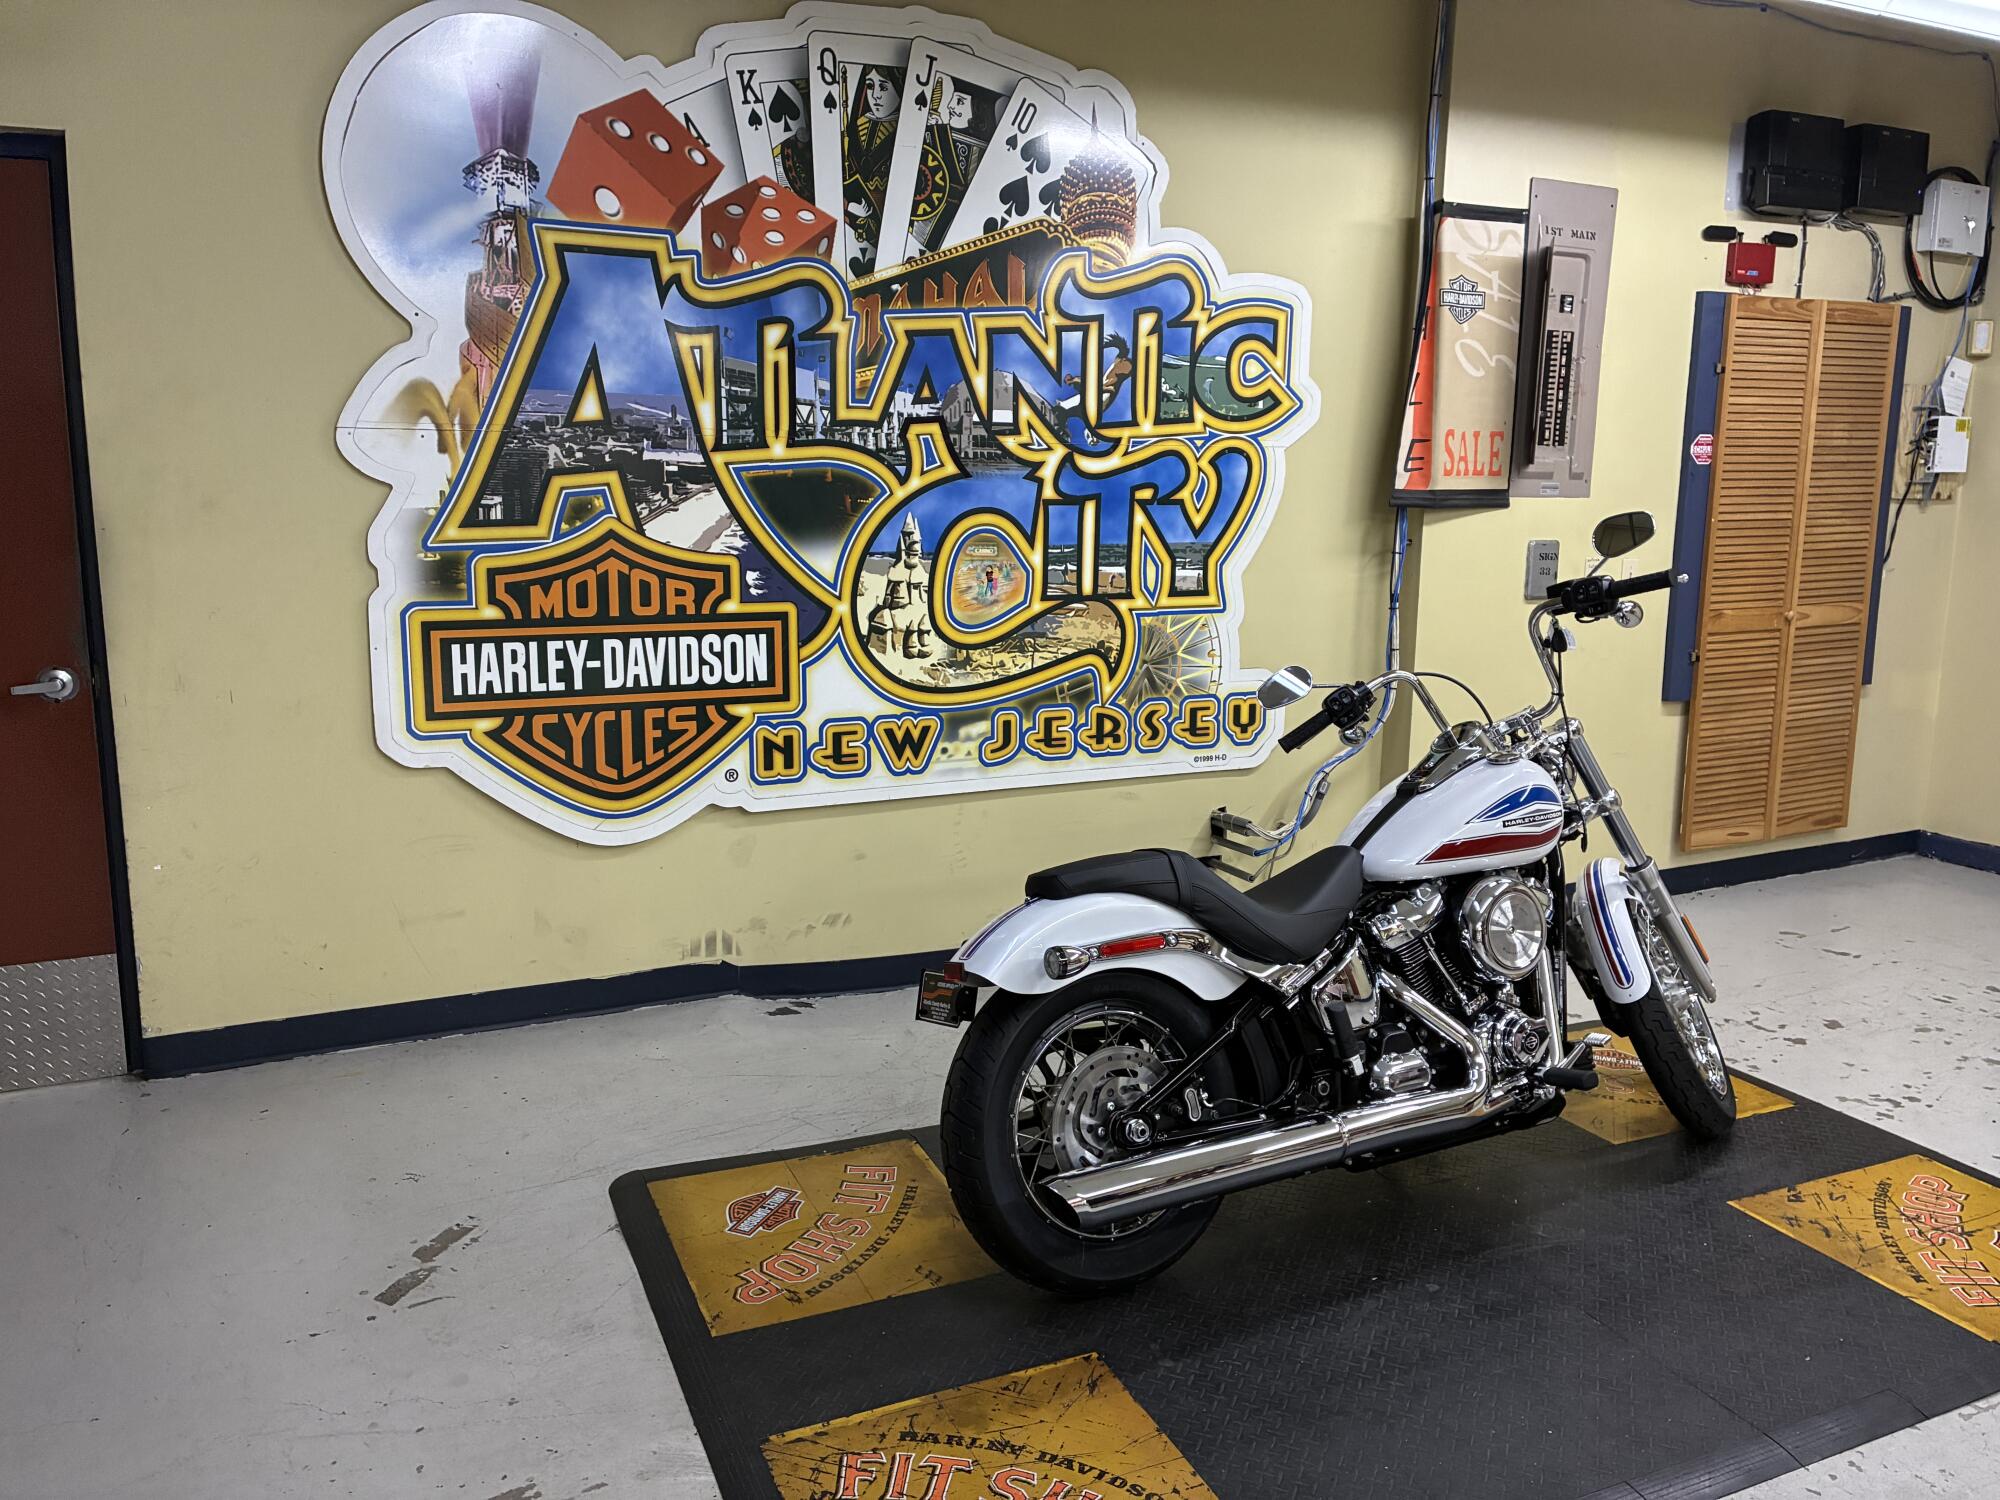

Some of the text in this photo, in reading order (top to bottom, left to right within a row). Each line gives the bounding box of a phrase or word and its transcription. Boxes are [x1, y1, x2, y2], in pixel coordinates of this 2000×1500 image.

[736, 69, 764, 105] K
[817, 47, 840, 86] Q
[915, 54, 938, 87] J
[1011, 98, 1038, 135] 10
[1545, 225, 1597, 241] 1ST MAIN
[430, 222, 1300, 600] ATLANTIC
[1443, 428, 1505, 477] SALE
[530, 556, 697, 619] MOTOR
[845, 428, 1266, 702] CITY
[450, 633, 768, 696] HARLEY-DAVIDSON
[531, 705, 698, 780] CYCLES
[754, 693, 1265, 782] NEW JERSEY
[1504, 811, 1562, 827] HARLEY-DAVIDSON
[733, 1164, 898, 1306] FIT SHOP
[1900, 1174, 1972, 1251] SHOP
[836, 1450, 974, 1500] FIT
